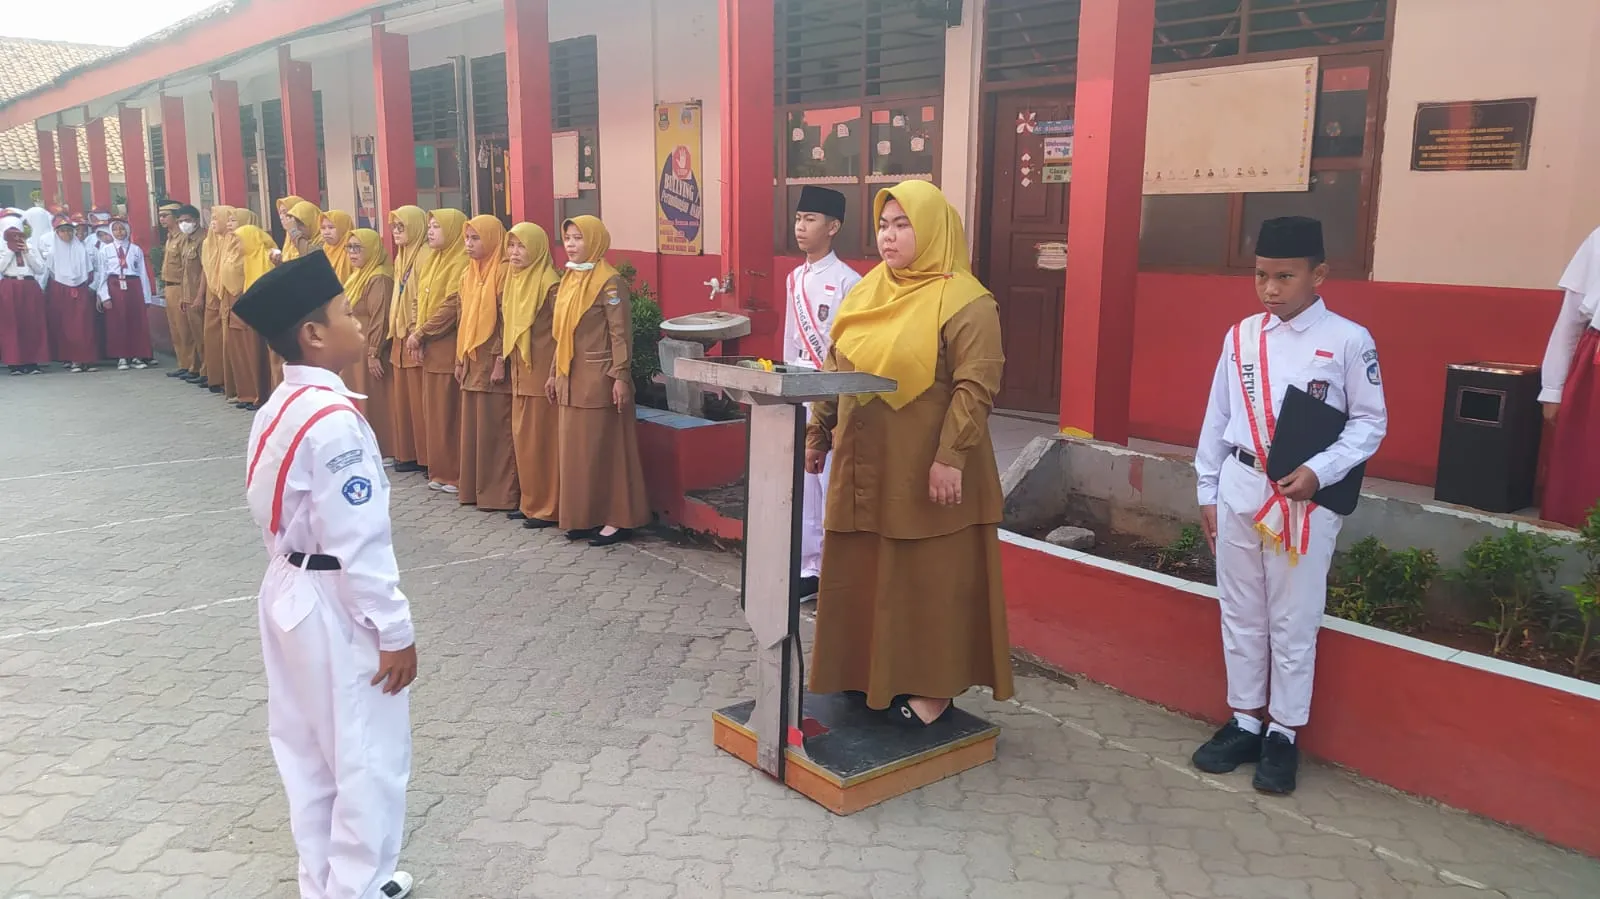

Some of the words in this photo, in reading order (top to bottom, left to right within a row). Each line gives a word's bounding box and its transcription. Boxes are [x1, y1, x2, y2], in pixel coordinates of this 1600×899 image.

[663, 173, 695, 201] BULLYING
[796, 294, 811, 333] PETUGAS
[808, 334, 824, 362] UPAC
